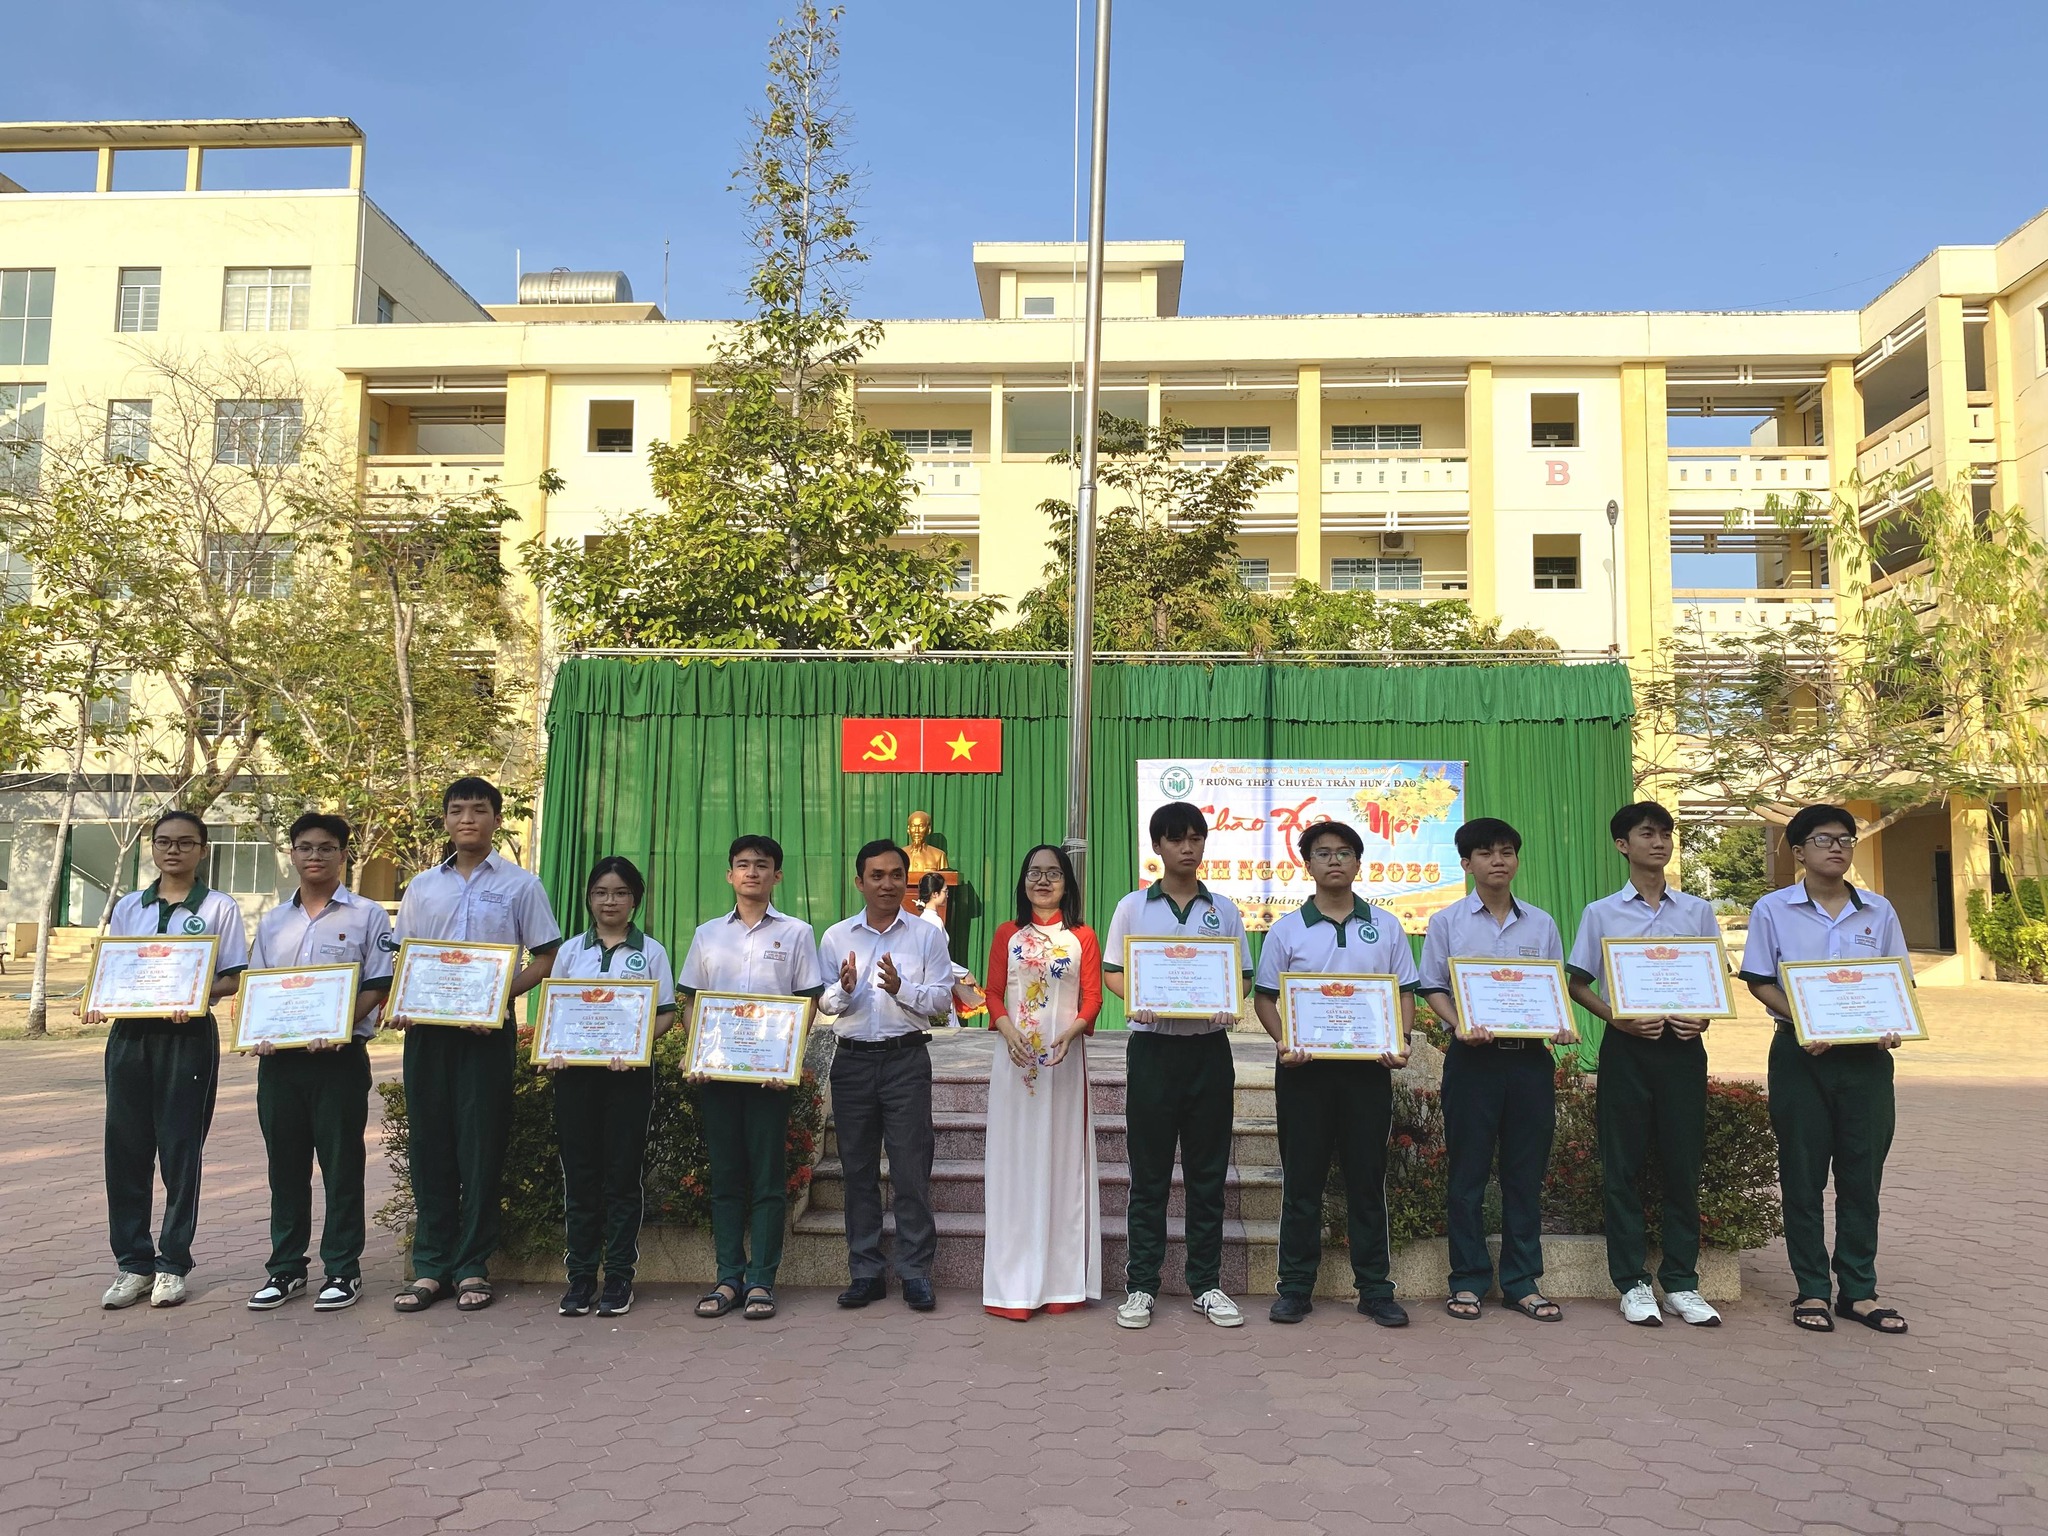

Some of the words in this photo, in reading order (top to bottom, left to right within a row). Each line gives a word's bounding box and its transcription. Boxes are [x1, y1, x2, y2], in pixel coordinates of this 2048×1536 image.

[1545, 460, 1570, 485] B
[1246, 779, 1274, 787] THPT
[1278, 777, 1322, 787] CHUYÊN
[1326, 776, 1355, 787] TRẦN
[1238, 860, 1296, 887] NGỌ
[1369, 862, 1441, 884] 2026
[1246, 896, 1261, 906] 23
[1265, 895, 1304, 908] tháng
